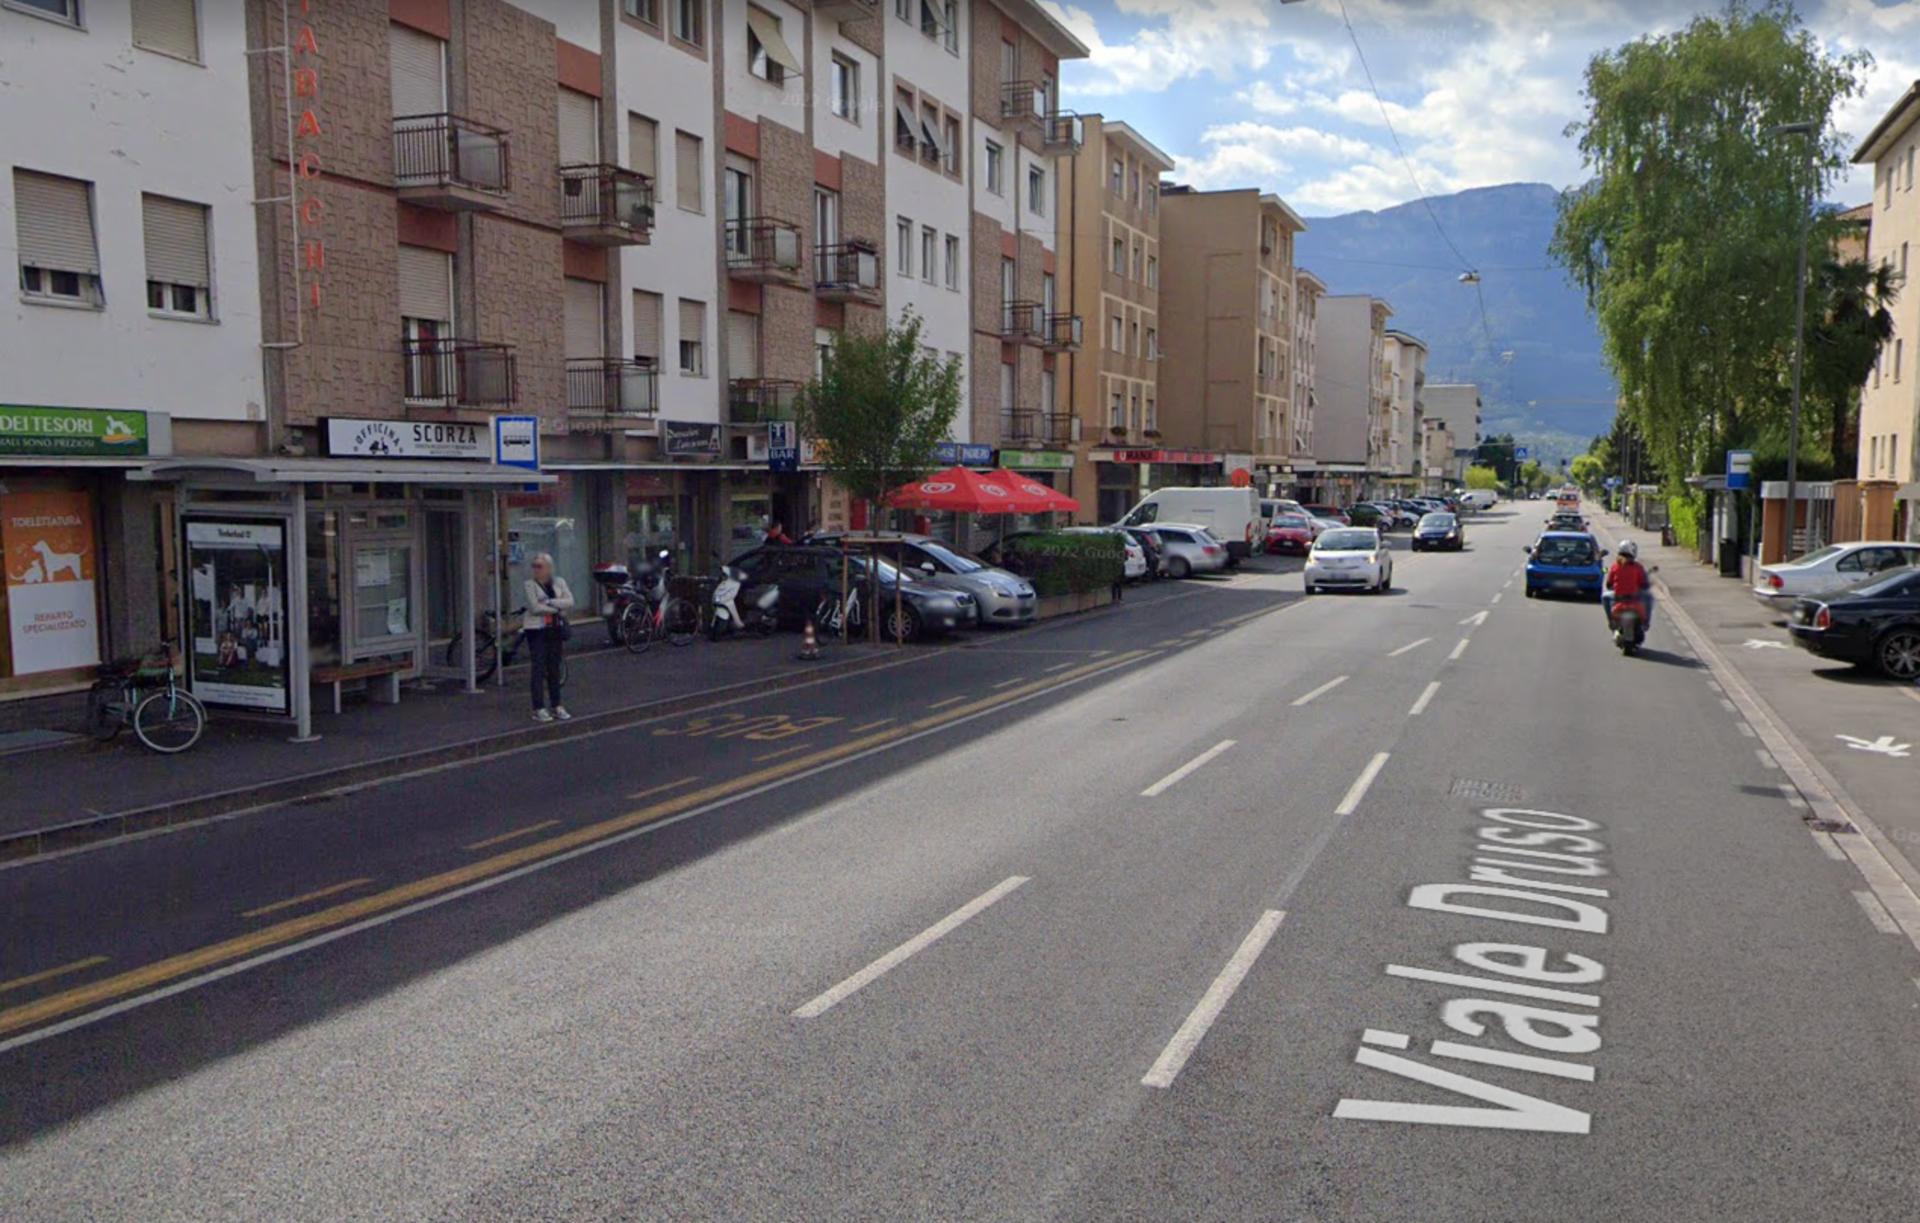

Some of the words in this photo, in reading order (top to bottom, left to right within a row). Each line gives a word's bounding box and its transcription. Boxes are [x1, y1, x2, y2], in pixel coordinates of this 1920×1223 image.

[0, 415, 28, 432] DEI
[31, 416, 93, 433] TESORI
[355, 423, 400, 446] OFFICINA
[413, 424, 477, 443] SCORZA
[771, 449, 795, 459] BAR
[34, 610, 75, 622] REPARTO
